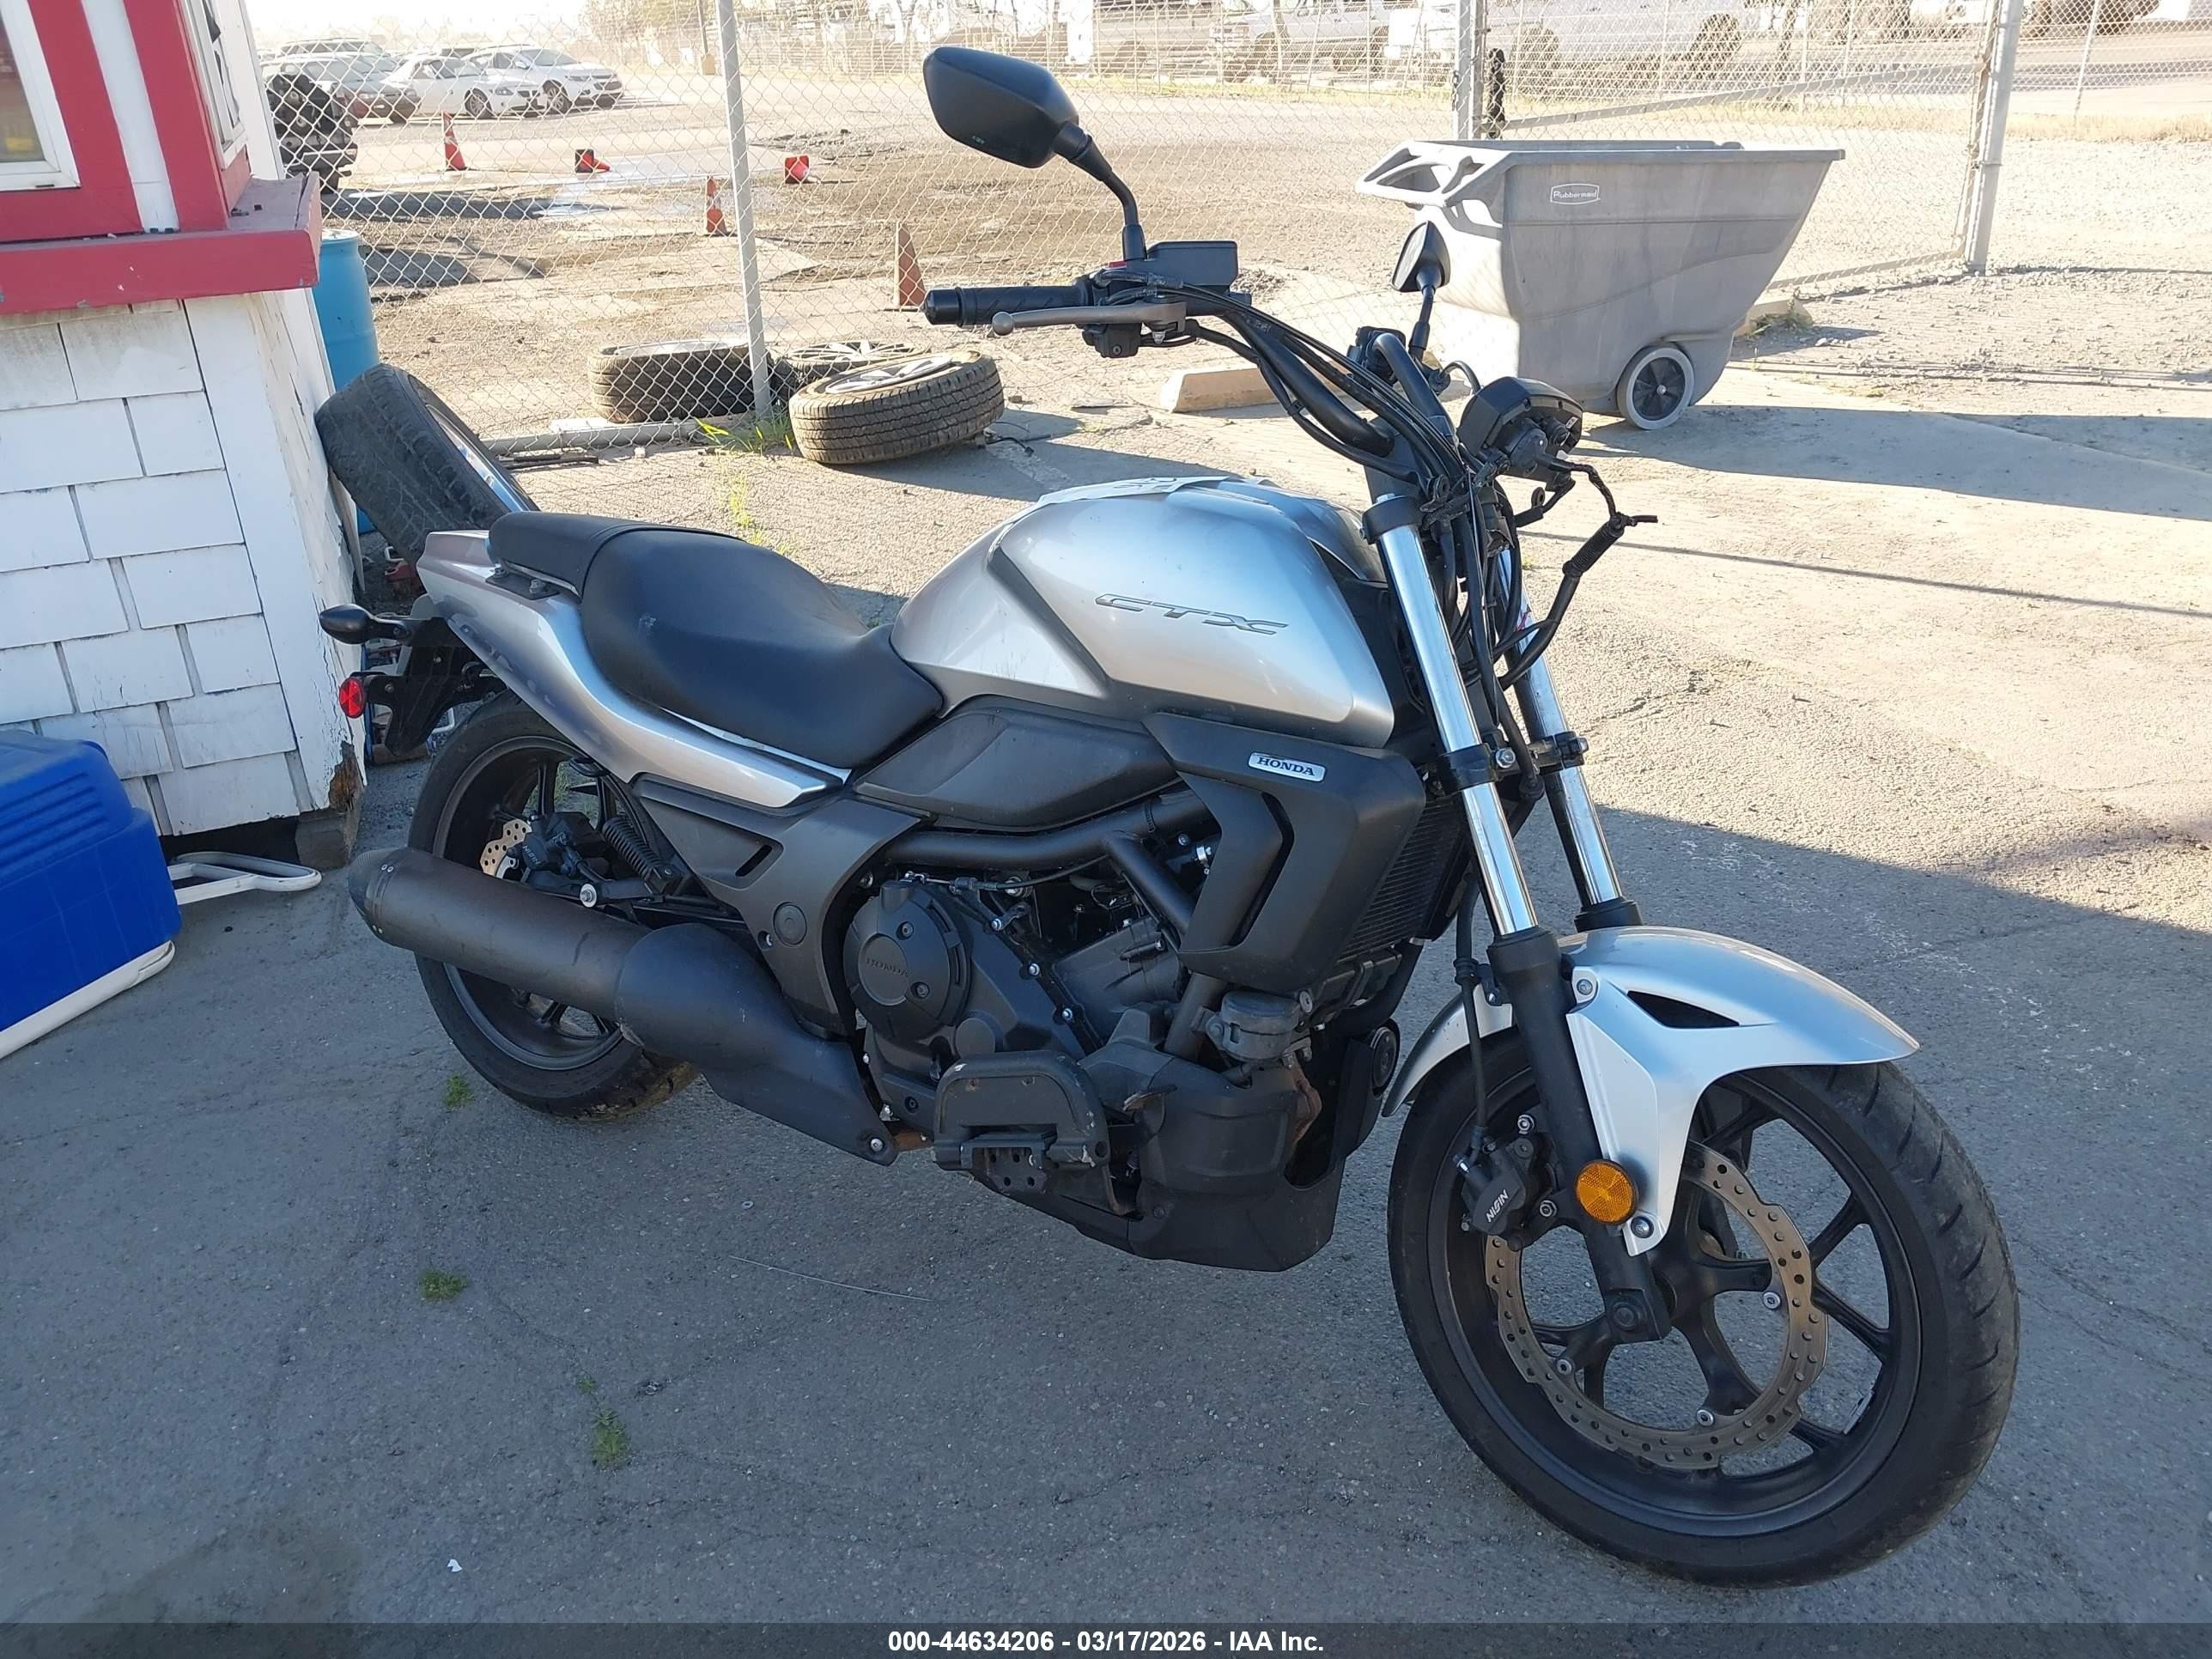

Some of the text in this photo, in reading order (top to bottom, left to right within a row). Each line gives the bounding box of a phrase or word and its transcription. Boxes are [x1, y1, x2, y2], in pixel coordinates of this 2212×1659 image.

[1553, 189, 1597, 199] Rubbermaid
[1095, 593, 1288, 635] CTX
[1256, 757, 1316, 776] HONDA
